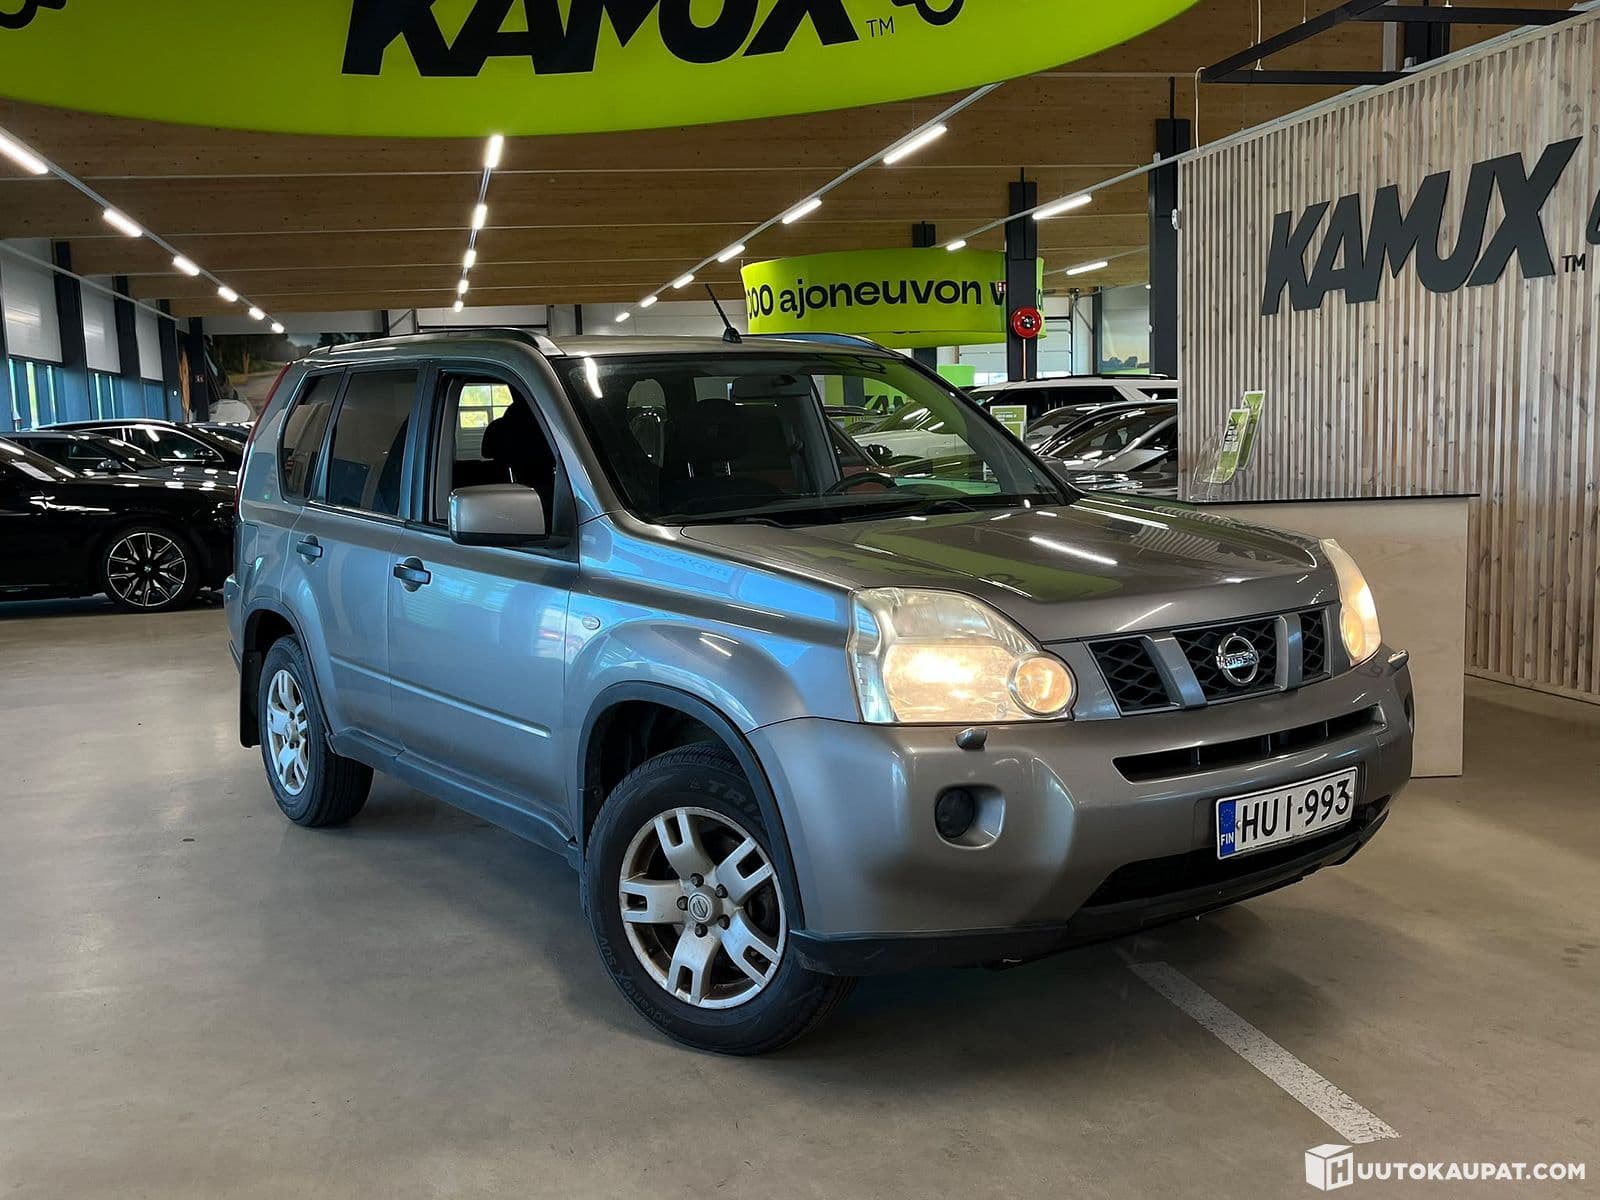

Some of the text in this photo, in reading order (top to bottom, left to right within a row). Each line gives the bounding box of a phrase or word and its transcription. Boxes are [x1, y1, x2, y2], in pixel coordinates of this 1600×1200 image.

[866, 16, 895, 38] TM
[1261, 136, 1586, 315] KAMUX TM
[780, 278, 981, 318] ajoneuvon
[1242, 778, 1351, 843] HUI-993
[1220, 832, 1235, 846] FIN
